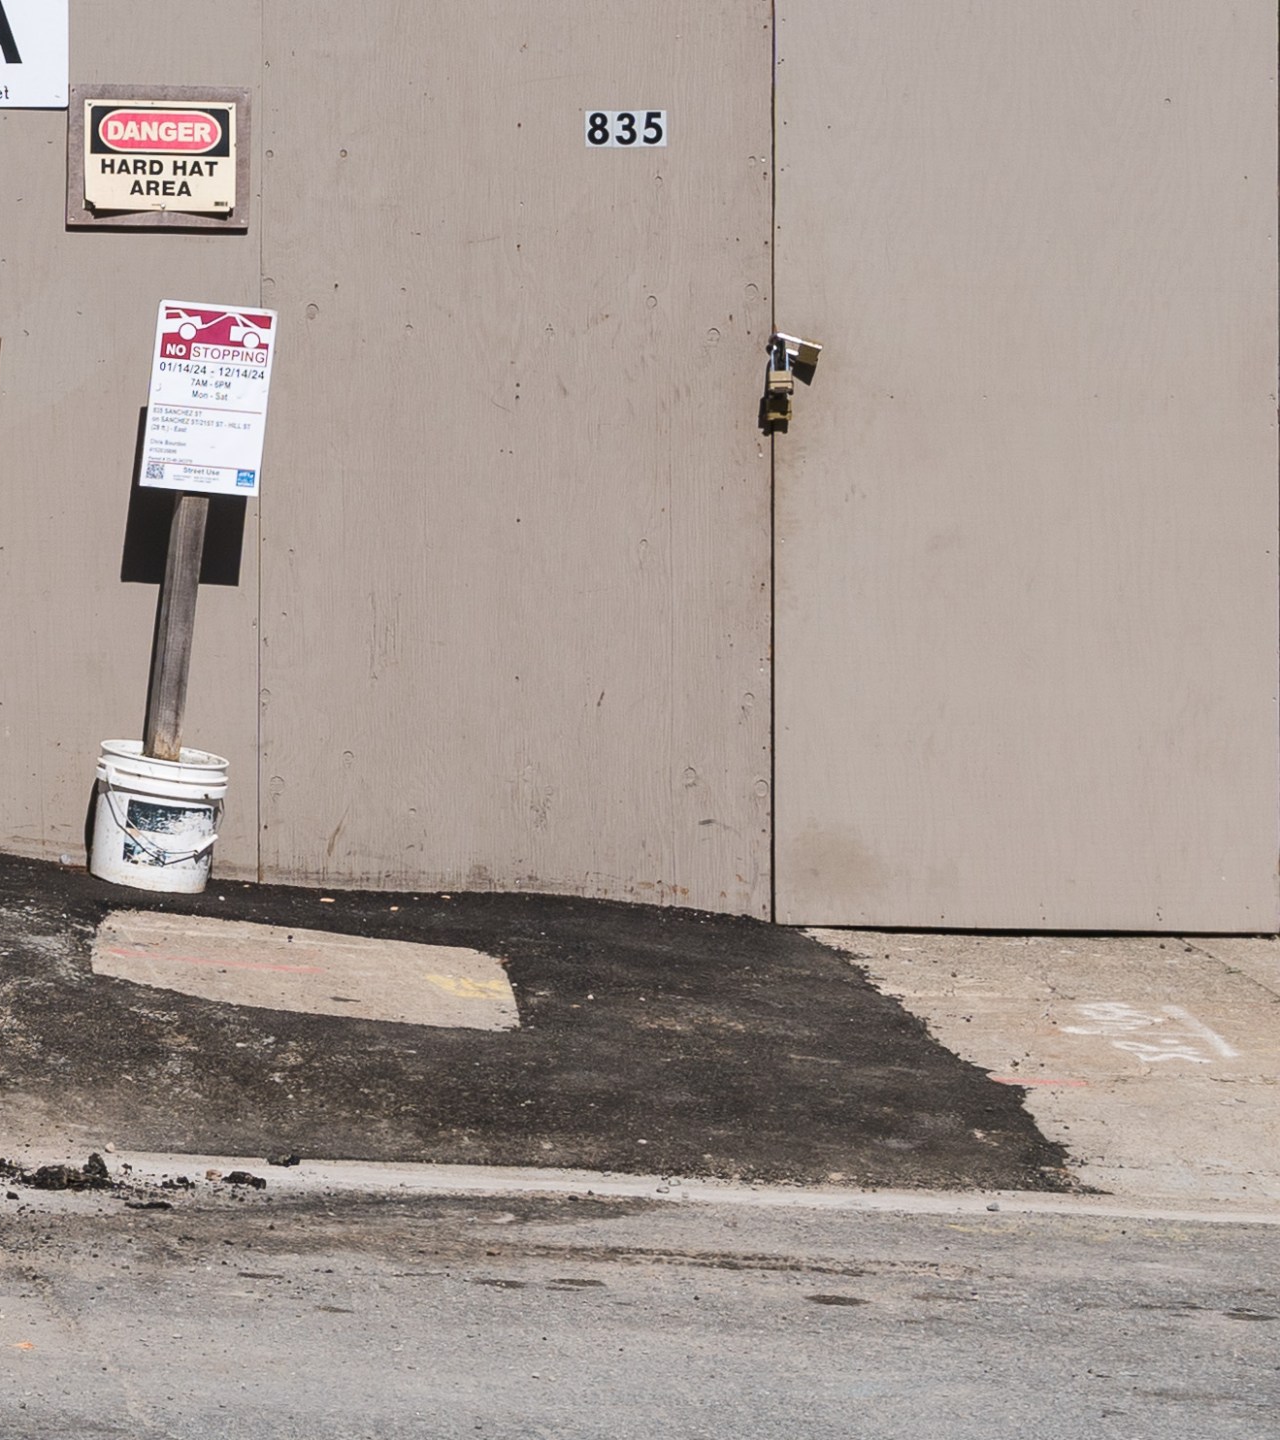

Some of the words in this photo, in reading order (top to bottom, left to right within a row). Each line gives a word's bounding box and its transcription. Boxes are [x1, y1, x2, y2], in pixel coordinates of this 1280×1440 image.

[107, 120, 212, 143] DANGER
[587, 111, 663, 145] 835
[100, 158, 163, 176] HARD
[173, 160, 219, 177] HAT
[129, 180, 192, 197] AREA
[166, 343, 186, 356] NO
[192, 346, 265, 363] STOPPING
[160, 361, 207, 375] 01/14/24
[219, 367, 265, 380] 12/14/24
[191, 378, 208, 387] 7AM
[192, 390, 208, 399] Mon
[215, 392, 228, 401] Sat
[164, 408, 193, 416] SANCHEZ
[161, 417, 190, 425] SANCHEZ
[183, 466, 205, 474] Street
[206, 468, 220, 476] Use
